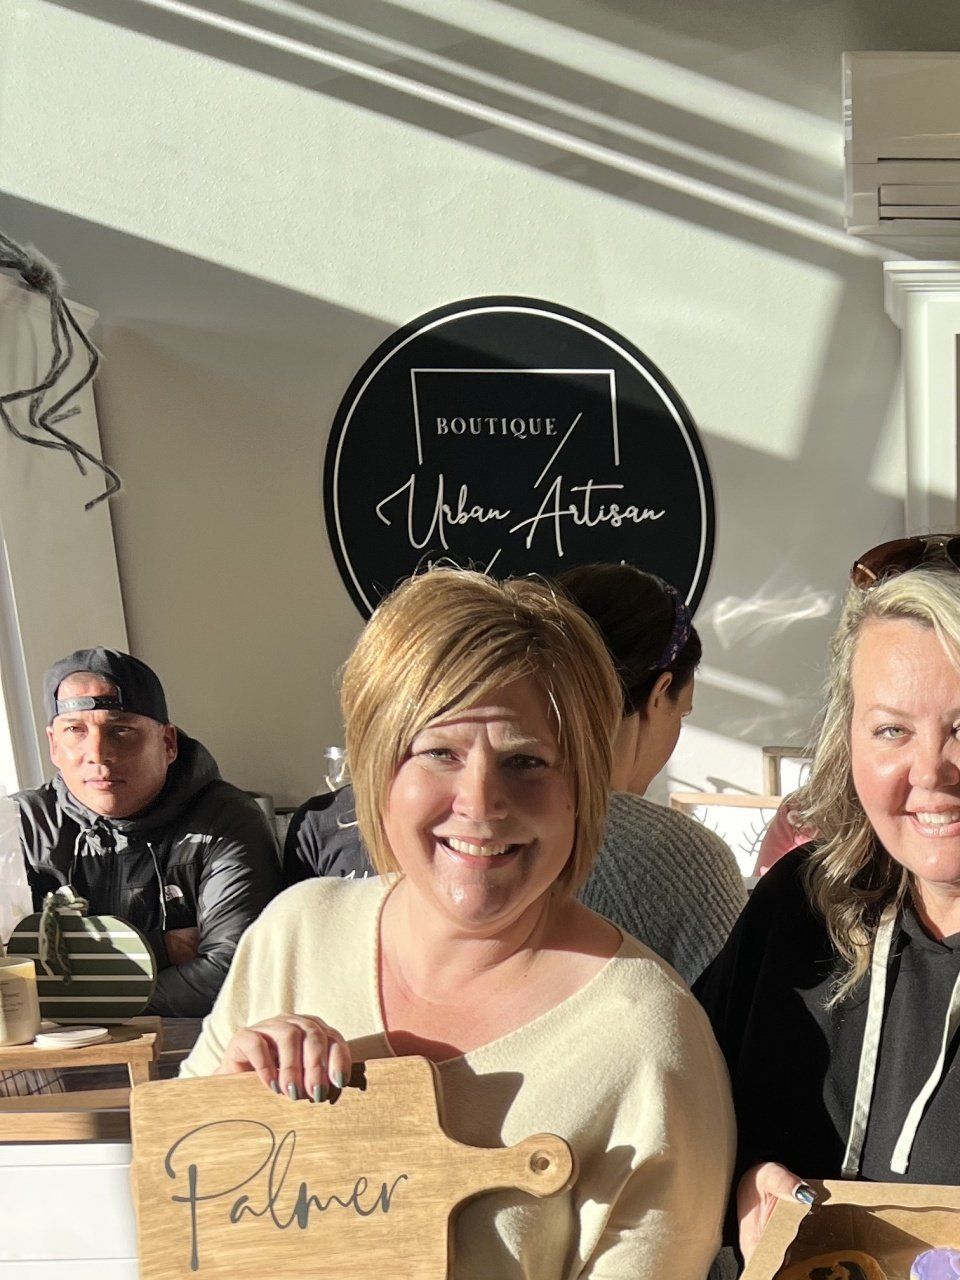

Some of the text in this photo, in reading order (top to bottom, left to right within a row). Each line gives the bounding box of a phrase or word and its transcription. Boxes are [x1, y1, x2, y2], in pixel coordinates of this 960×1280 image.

[436, 417, 558, 439] BOUTIQUE
[375, 473, 666, 558] Urban Artisan
[164, 1118, 409, 1272] Palmer
